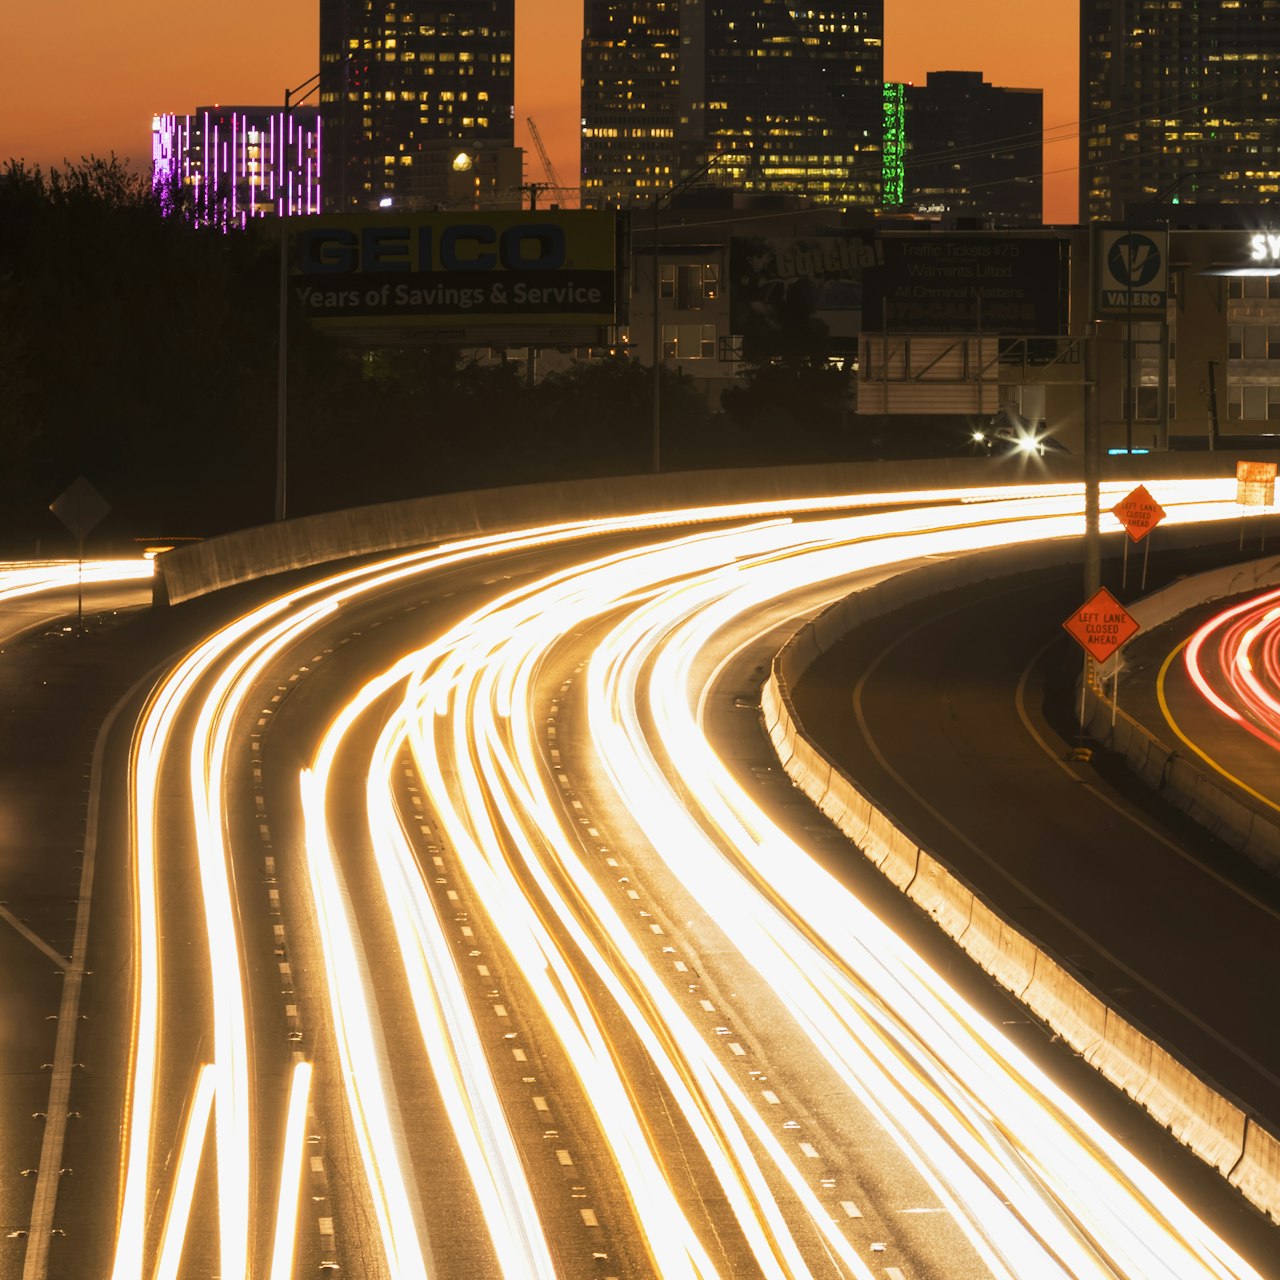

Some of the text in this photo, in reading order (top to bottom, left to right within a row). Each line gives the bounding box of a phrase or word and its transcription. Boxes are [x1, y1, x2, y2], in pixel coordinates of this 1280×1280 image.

[301, 224, 566, 273] GEICO
[900, 242, 942, 257] Traffic
[945, 242, 991, 257] Tickets
[907, 264, 1013, 278] Warrants Lifted
[295, 281, 602, 309] Years of Savings & Service
[895, 285, 1025, 297] All Criminal Matters
[1126, 511, 1152, 520] CLOSED
[1128, 519, 1150, 528] AHEAD
[1079, 613, 1127, 623] LEFT LANE
[1086, 624, 1119, 634] CLOSED
[1088, 635, 1118, 645] AHEAD
